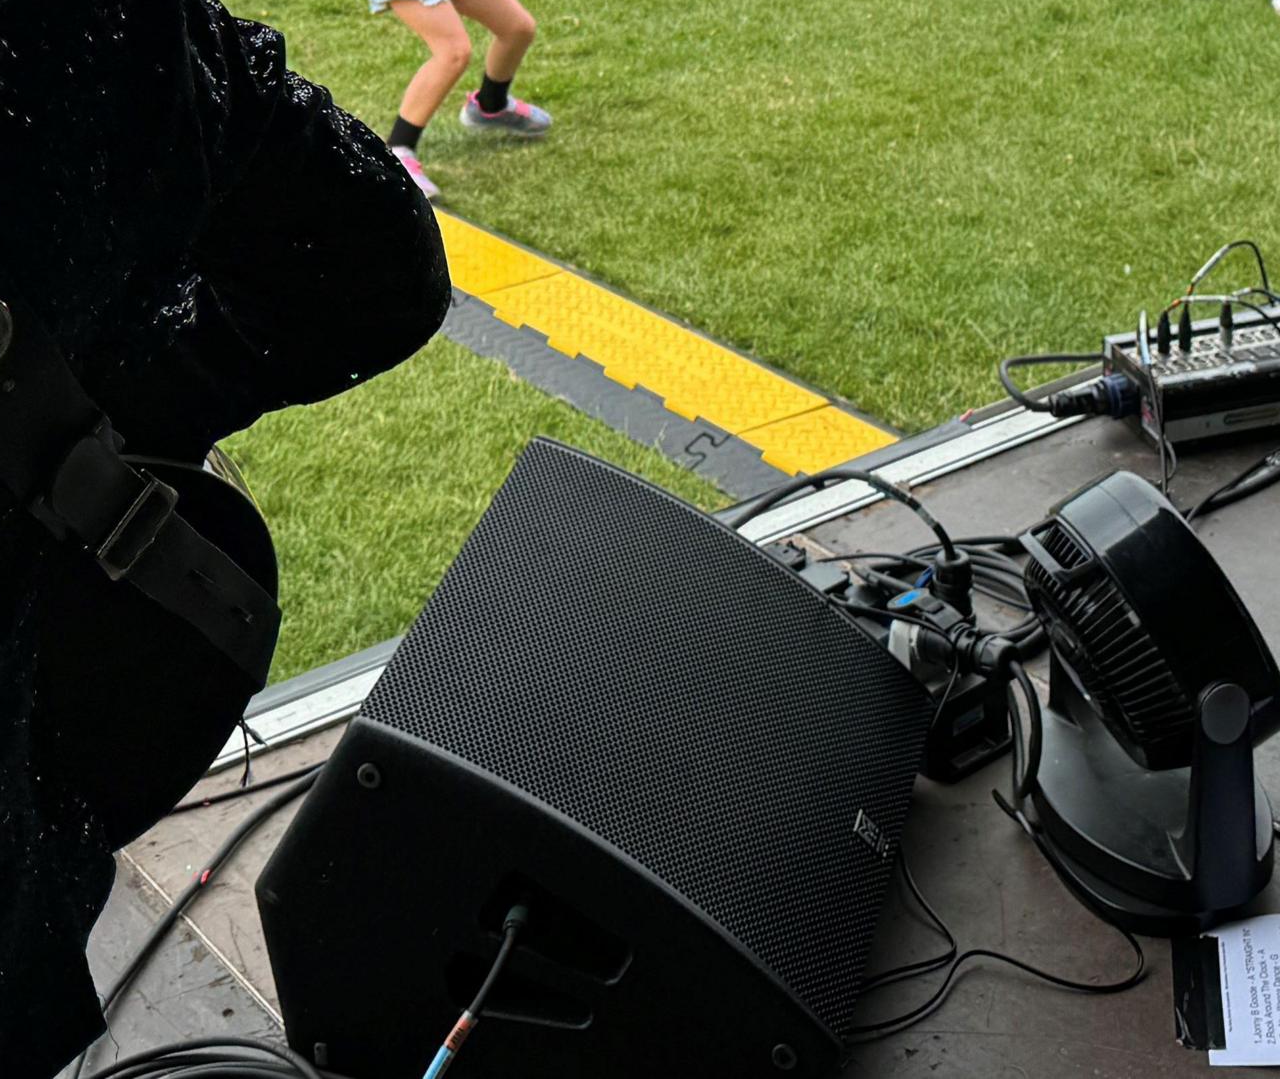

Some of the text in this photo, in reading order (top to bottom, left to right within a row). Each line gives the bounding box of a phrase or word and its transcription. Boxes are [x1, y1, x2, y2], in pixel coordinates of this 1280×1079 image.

[1258, 960, 1269, 978] Clock
[1261, 980, 1269, 992] The
[1249, 985, 1259, 1008] Goode
[1263, 993, 1273, 1018] Around
